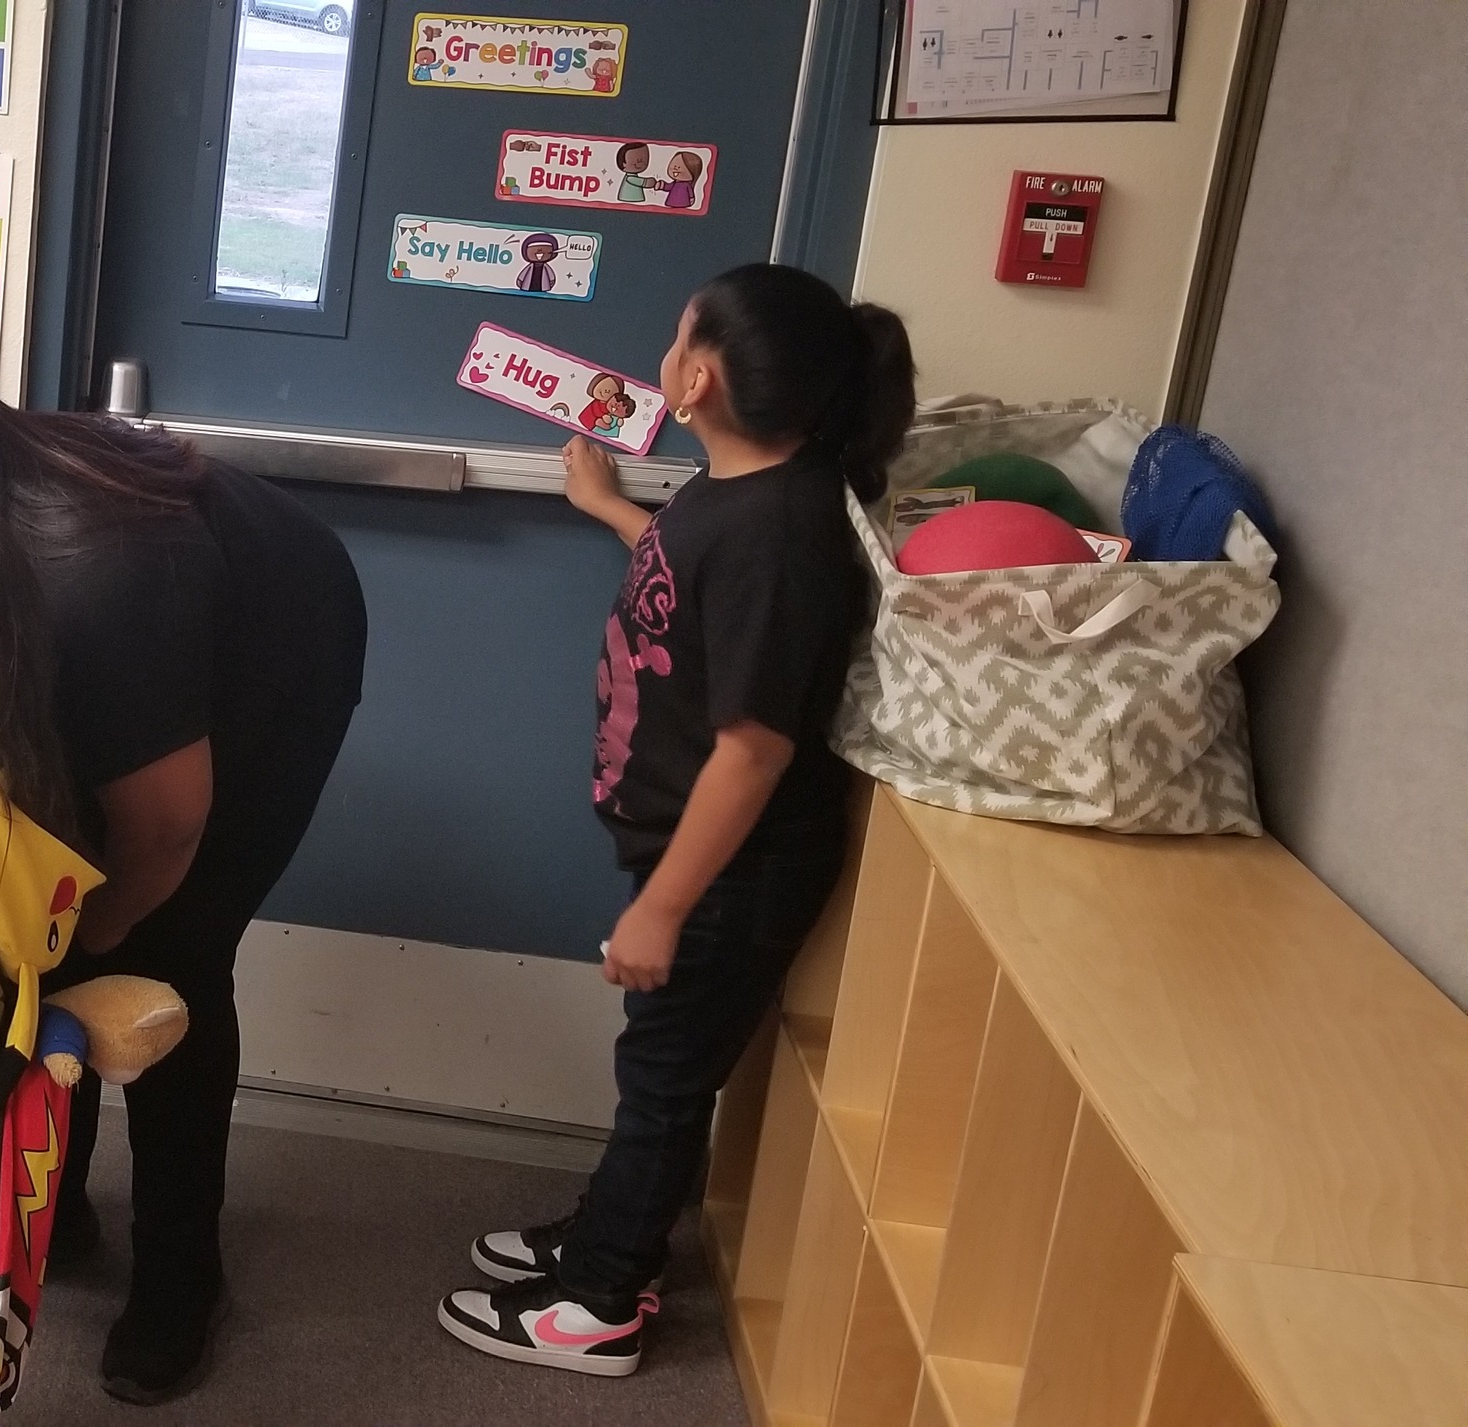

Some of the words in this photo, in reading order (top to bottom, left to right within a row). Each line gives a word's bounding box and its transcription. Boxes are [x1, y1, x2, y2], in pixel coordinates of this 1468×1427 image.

[445, 35, 587, 74] Greetings
[545, 143, 592, 168] Fist
[529, 167, 601, 197] Bump
[1026, 176, 1046, 190] FIRE
[1072, 180, 1102, 193] ALARM
[1045, 208, 1067, 218] PUSH
[1030, 221, 1049, 230] PULL
[1055, 223, 1078, 232] DOWN
[407, 236, 450, 263] Say
[457, 240, 513, 265] Hello
[569, 243, 592, 252] HELLO
[502, 353, 559, 399] Hug
